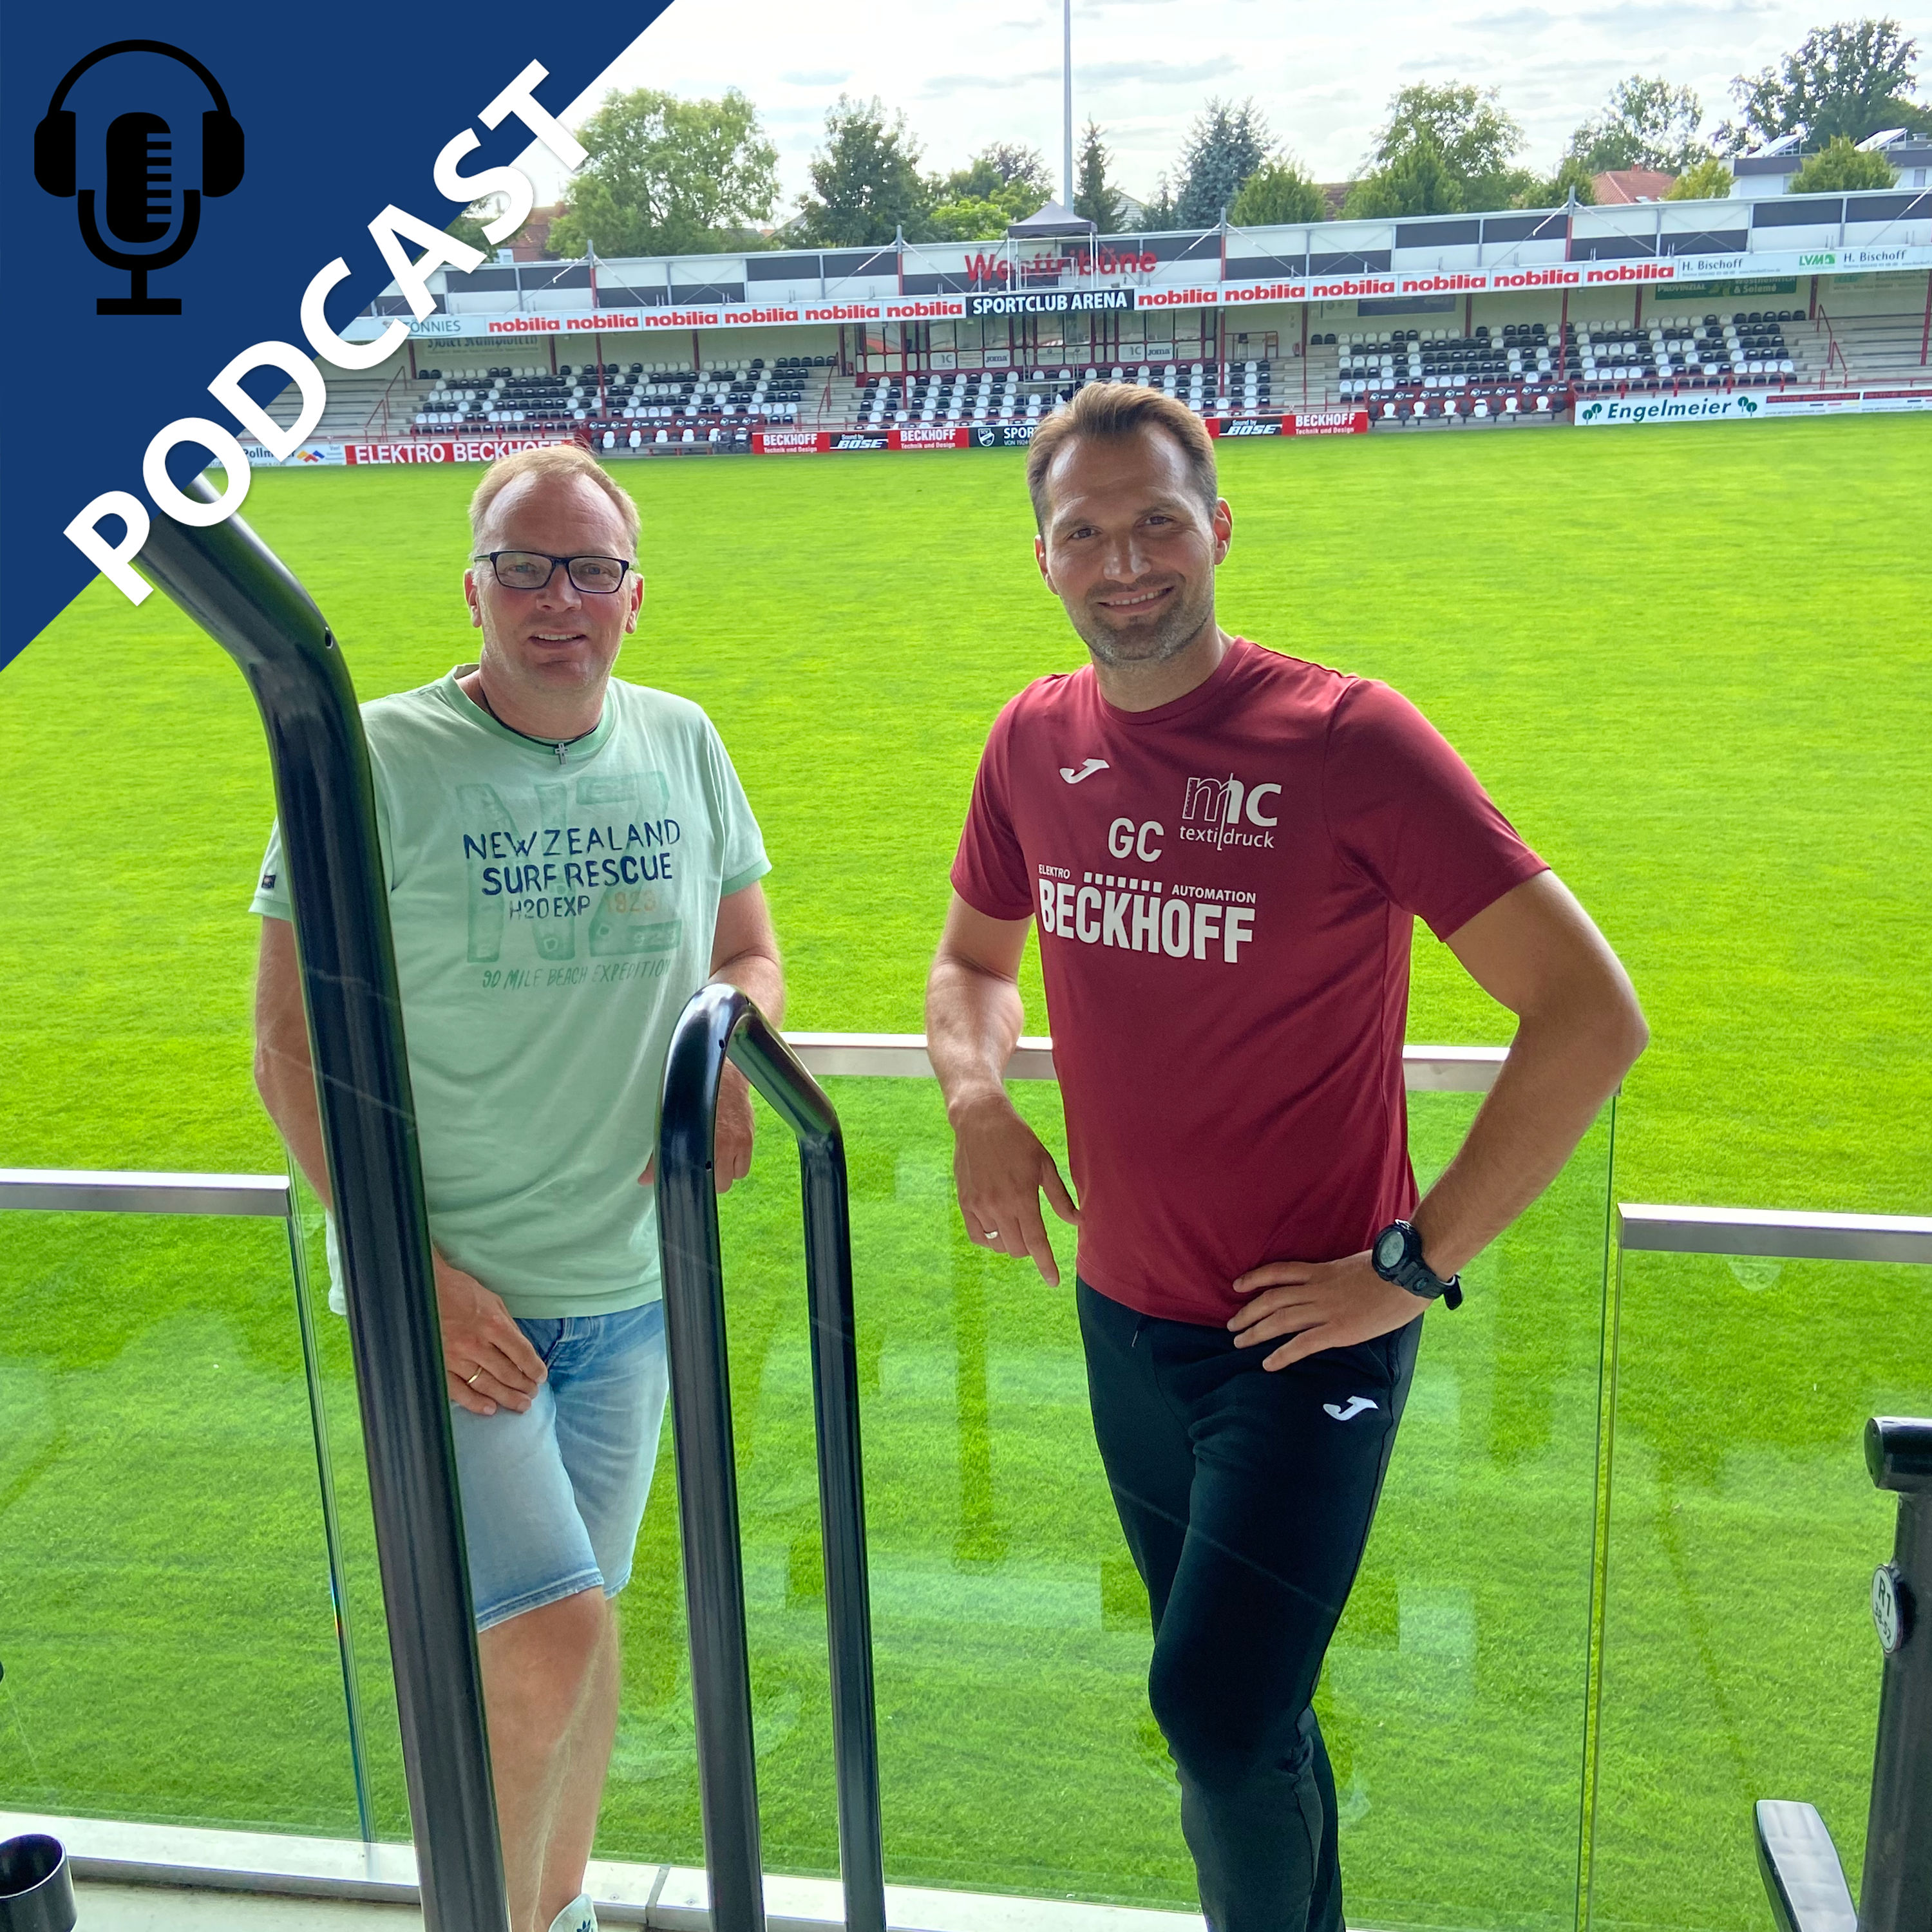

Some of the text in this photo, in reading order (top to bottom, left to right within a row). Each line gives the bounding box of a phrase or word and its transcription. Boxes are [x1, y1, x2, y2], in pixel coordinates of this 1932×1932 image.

[965, 248, 1157, 281] Westtrbüne
[1682, 258, 1743, 271] H. Bischoff
[1799, 254, 1824, 266] LVM
[1844, 250, 1907, 262] H. Bischoff
[1138, 289, 1218, 306] nobilia
[1225, 284, 1305, 301] nobilia
[1312, 279, 1395, 296] nobilia
[1403, 274, 1486, 292] nobilia
[1494, 270, 1579, 287] nobilia
[1587, 264, 1674, 281] nobilia
[972, 292, 1128, 314] SPORTCLUB ARENA
[403, 319, 460, 332] ÖNNIES
[489, 301, 962, 332] nobilia nobilia nobilia nobilia nobilia nobilia
[1295, 413, 1355, 427] BECKHOFF
[1607, 398, 1732, 422] Engelmeier
[762, 433, 818, 446] BECKHOFF
[900, 428, 956, 441] BECKHOFF
[1224, 424, 1282, 435] BOSE
[243, 448, 294, 458] Pollmr
[355, 444, 446, 464] ELEKTRO
[836, 439, 888, 450] BOSE
[463, 819, 680, 860] NEW ZEALAND
[1108, 817, 1165, 862] GC
[482, 853, 672, 896] SURF RESCUE
[1038, 864, 1256, 904] ELEKTRO AUTOMATION
[553, 895, 591, 918] EXP
[1039, 878, 1256, 963] BECKHOFF
[482, 970, 501, 989] 90
[547, 966, 588, 986] BEACH
[592, 959, 671, 983] EXPEDITION
[1878, 1576, 1891, 1617] R1
